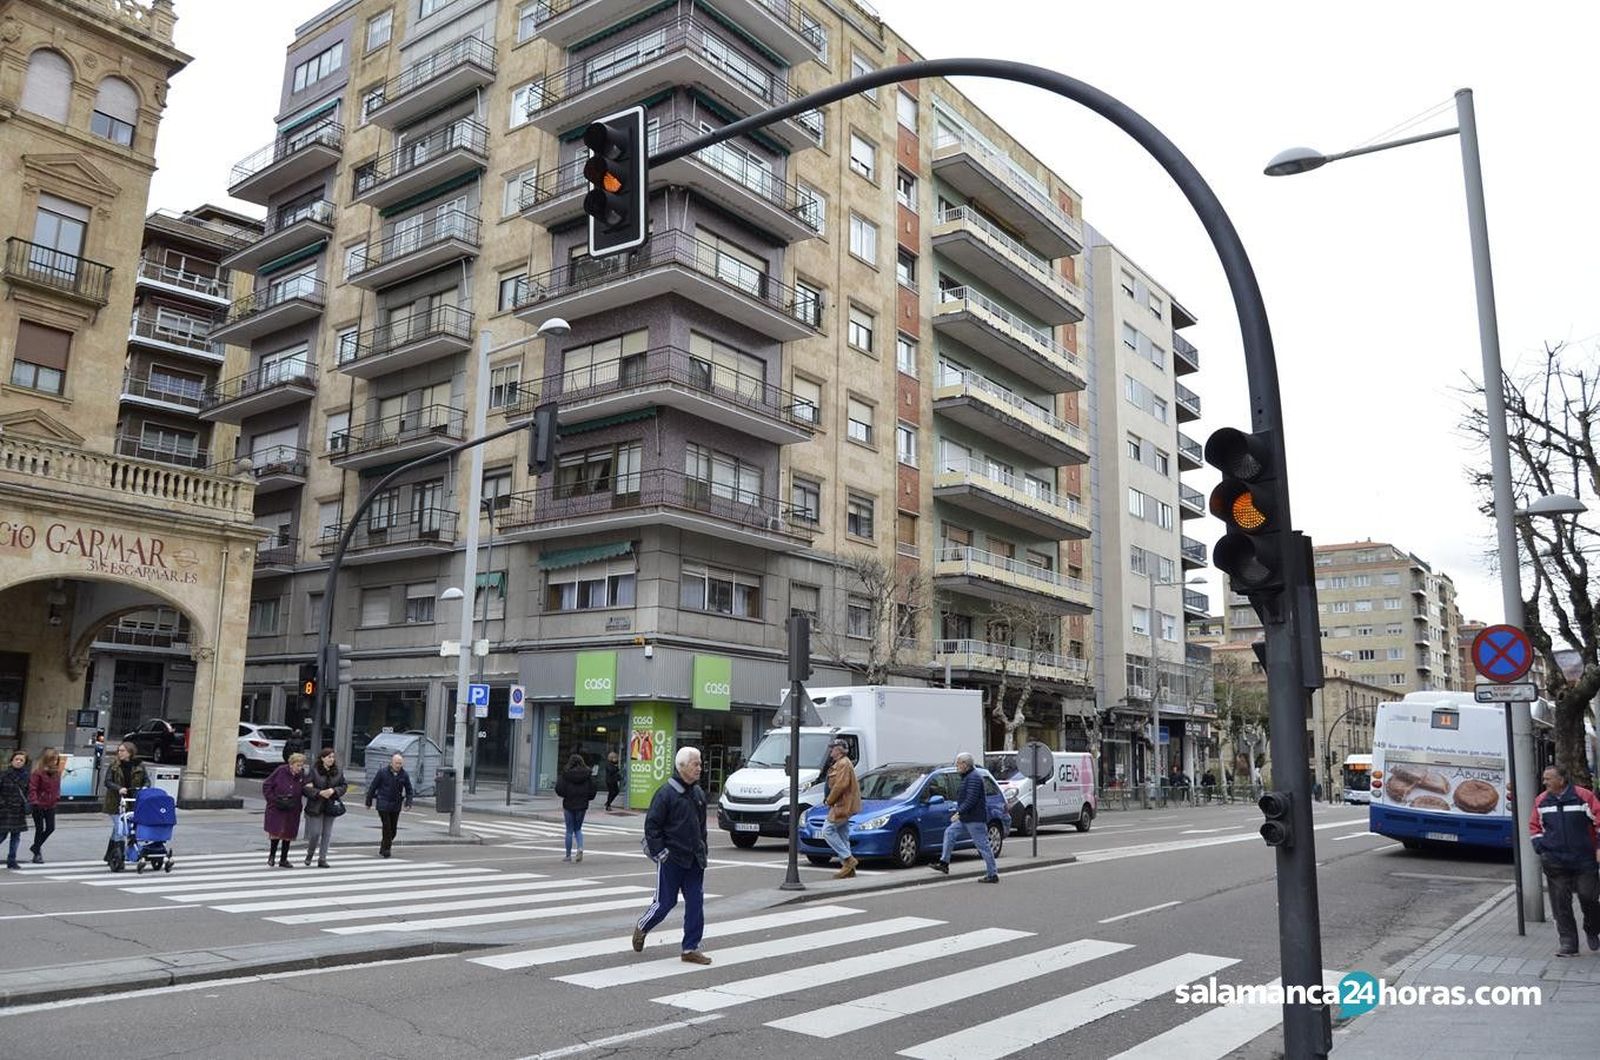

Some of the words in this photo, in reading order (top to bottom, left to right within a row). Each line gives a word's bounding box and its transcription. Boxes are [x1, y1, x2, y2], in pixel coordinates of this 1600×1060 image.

[46, 523, 167, 569] GARMAR
[584, 678, 611, 690] casa
[704, 682, 730, 695] casa
[471, 687, 485, 704] P
[632, 716, 653, 725] casa
[653, 730, 666, 781] casa
[631, 763, 651, 773] casa
[740, 786, 763, 794] IVECO
